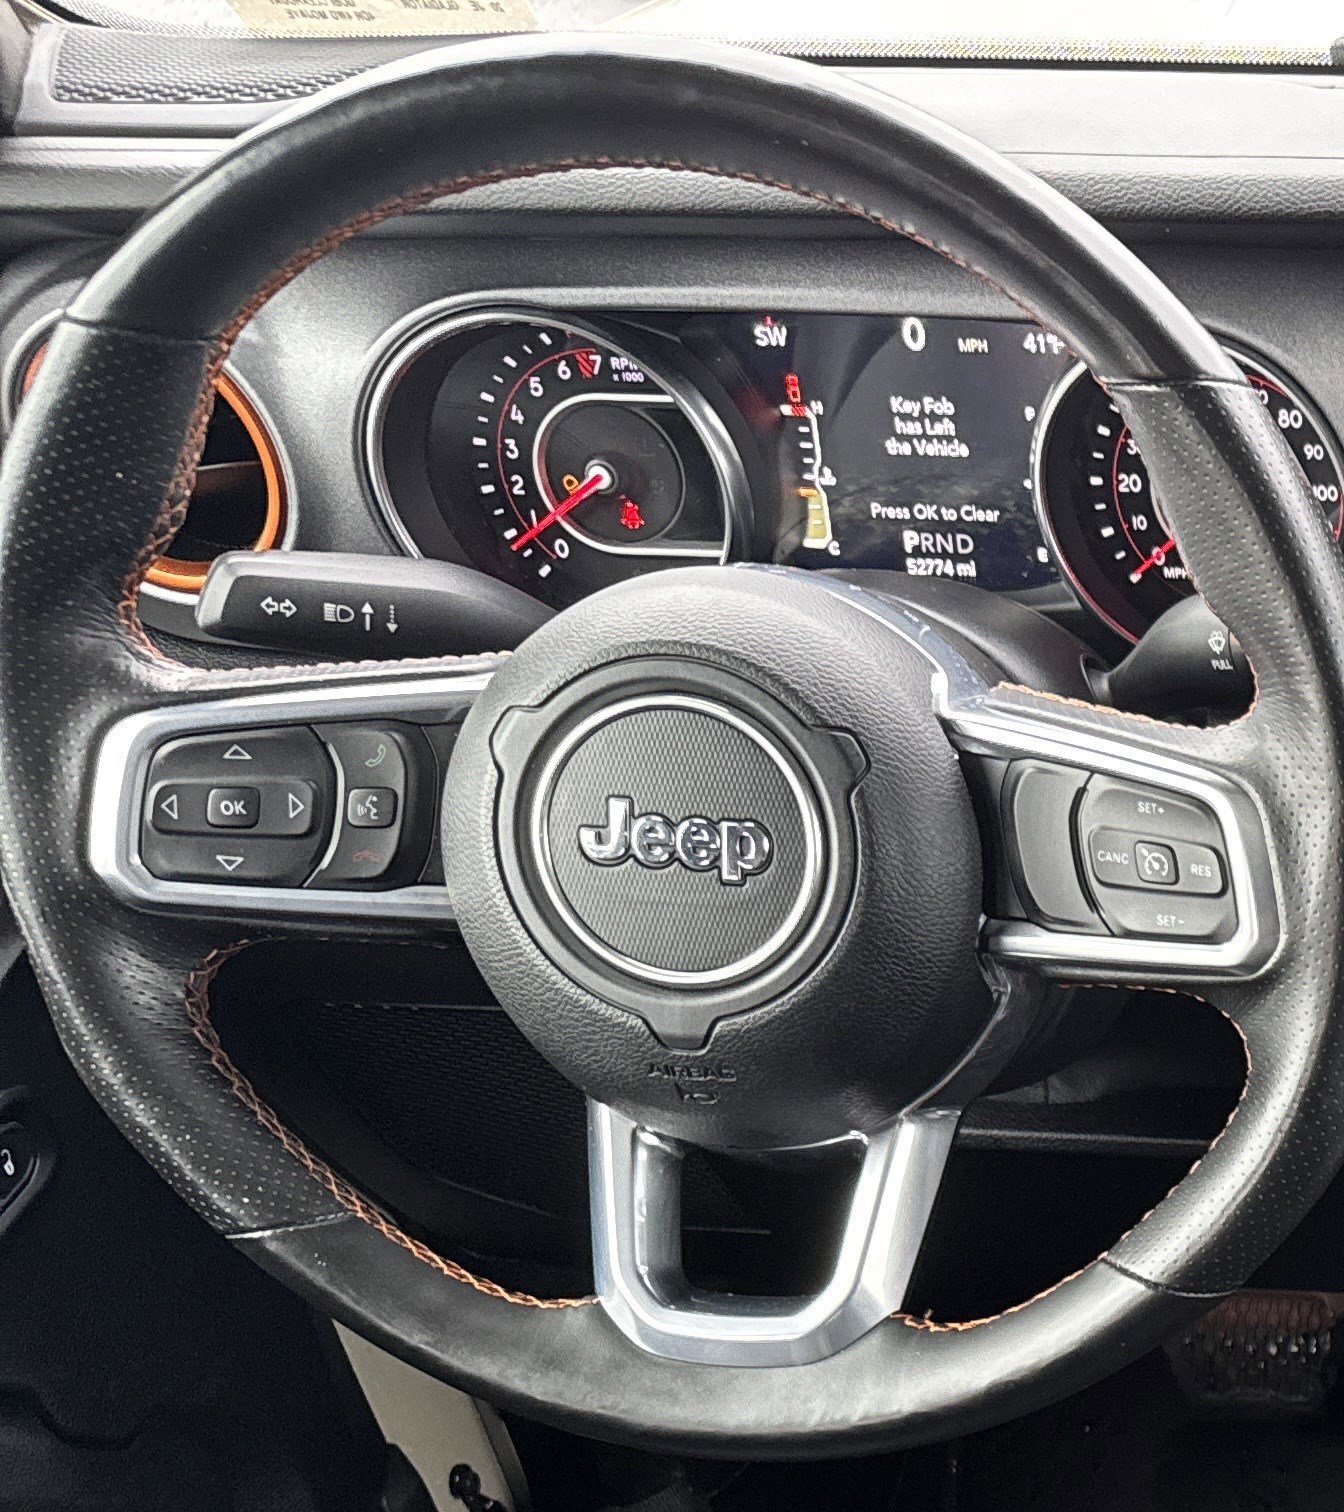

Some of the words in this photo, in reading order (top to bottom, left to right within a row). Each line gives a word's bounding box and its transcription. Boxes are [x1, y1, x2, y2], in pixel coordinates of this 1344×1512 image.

[754, 325, 787, 347] SW
[902, 316, 926, 351] 0
[958, 338, 989, 353] MPH
[557, 360, 571, 380] 6
[588, 355, 601, 375] 7
[529, 376, 544, 397] 5
[510, 404, 524, 425] 4
[810, 400, 824, 415] H
[890, 396, 921, 417] Key
[922, 396, 955, 415] Fob
[894, 416, 923, 435] has
[924, 417, 956, 436] Left
[1278, 408, 1303, 429] 80
[504, 438, 519, 459] 3
[885, 437, 912, 455] the
[912, 438, 970, 457] Vehicle
[1127, 439, 1141, 456] 3
[1303, 443, 1324, 461] 90
[510, 474, 525, 495] 2
[1118, 473, 1142, 493] 20
[870, 502, 911, 520] Press
[913, 503, 940, 521] OK
[940, 506, 958, 522] to
[960, 504, 1001, 522] Clear
[1132, 515, 1148, 531] 10
[554, 538, 569, 559] 0
[902, 529, 974, 555] PRND
[906, 557, 955, 577] 52774
[956, 559, 977, 578] mi
[220, 800, 247, 816] OK
[578, 795, 774, 886] Jeep
[1097, 850, 1129, 865] CANC
[1190, 864, 1212, 878] RES
